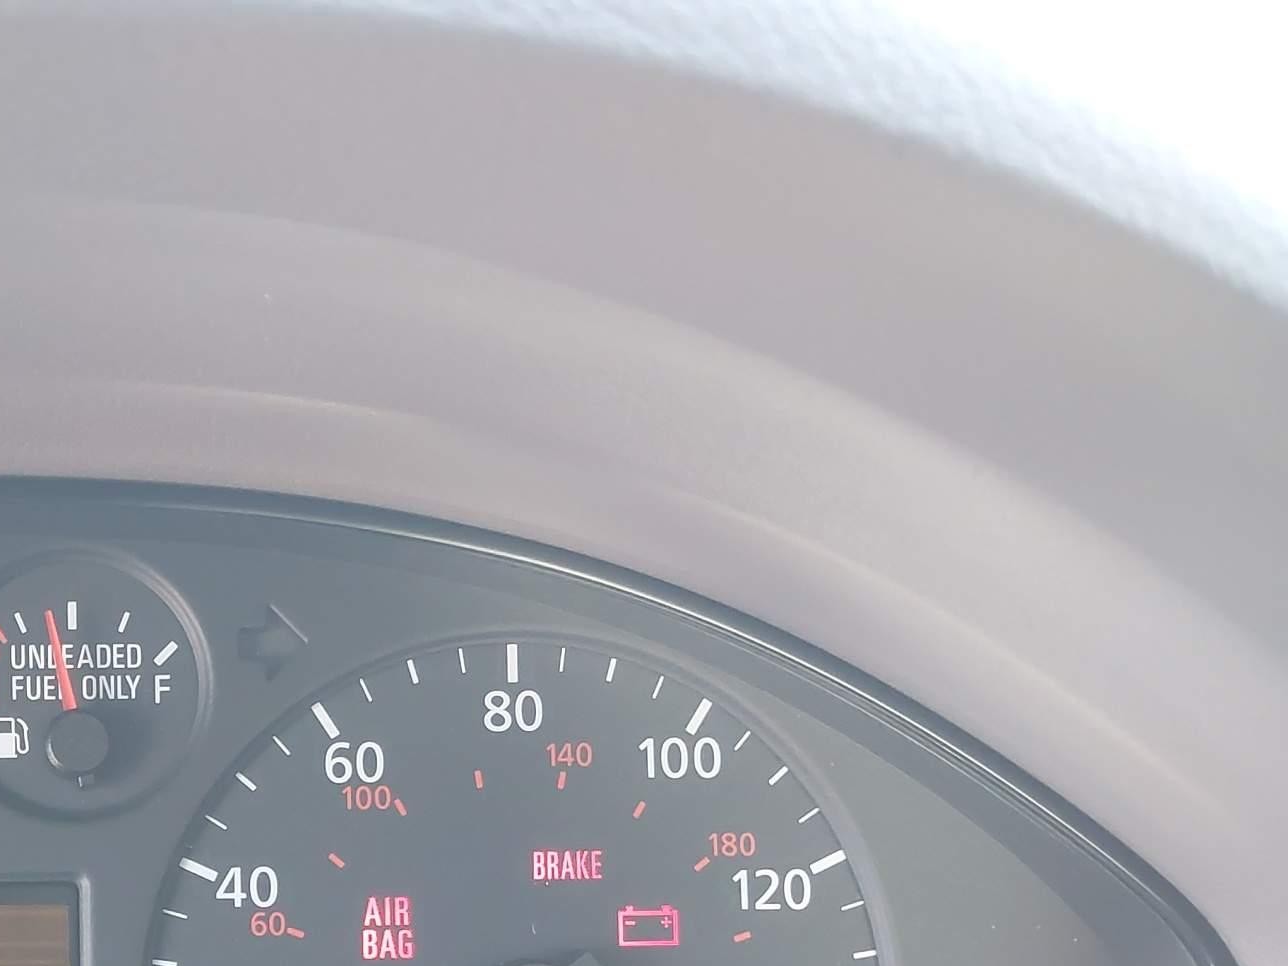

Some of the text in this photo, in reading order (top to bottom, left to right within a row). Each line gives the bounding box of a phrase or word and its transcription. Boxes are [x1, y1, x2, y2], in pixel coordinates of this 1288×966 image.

[10, 643, 143, 669] UNLEADED
[81, 674, 142, 700] ONLY
[154, 674, 172, 705] F
[481, 688, 545, 734] 80
[322, 739, 386, 786] 60
[544, 742, 595, 768] 140
[638, 734, 724, 780] 100
[340, 785, 394, 812] 100
[708, 831, 758, 858] 180
[532, 850, 603, 881] BRAKE
[214, 865, 280, 910] 40
[731, 868, 812, 912] 120
[249, 910, 287, 937] 60
[362, 896, 411, 928] AIR
[360, 928, 414, 961] BAG
